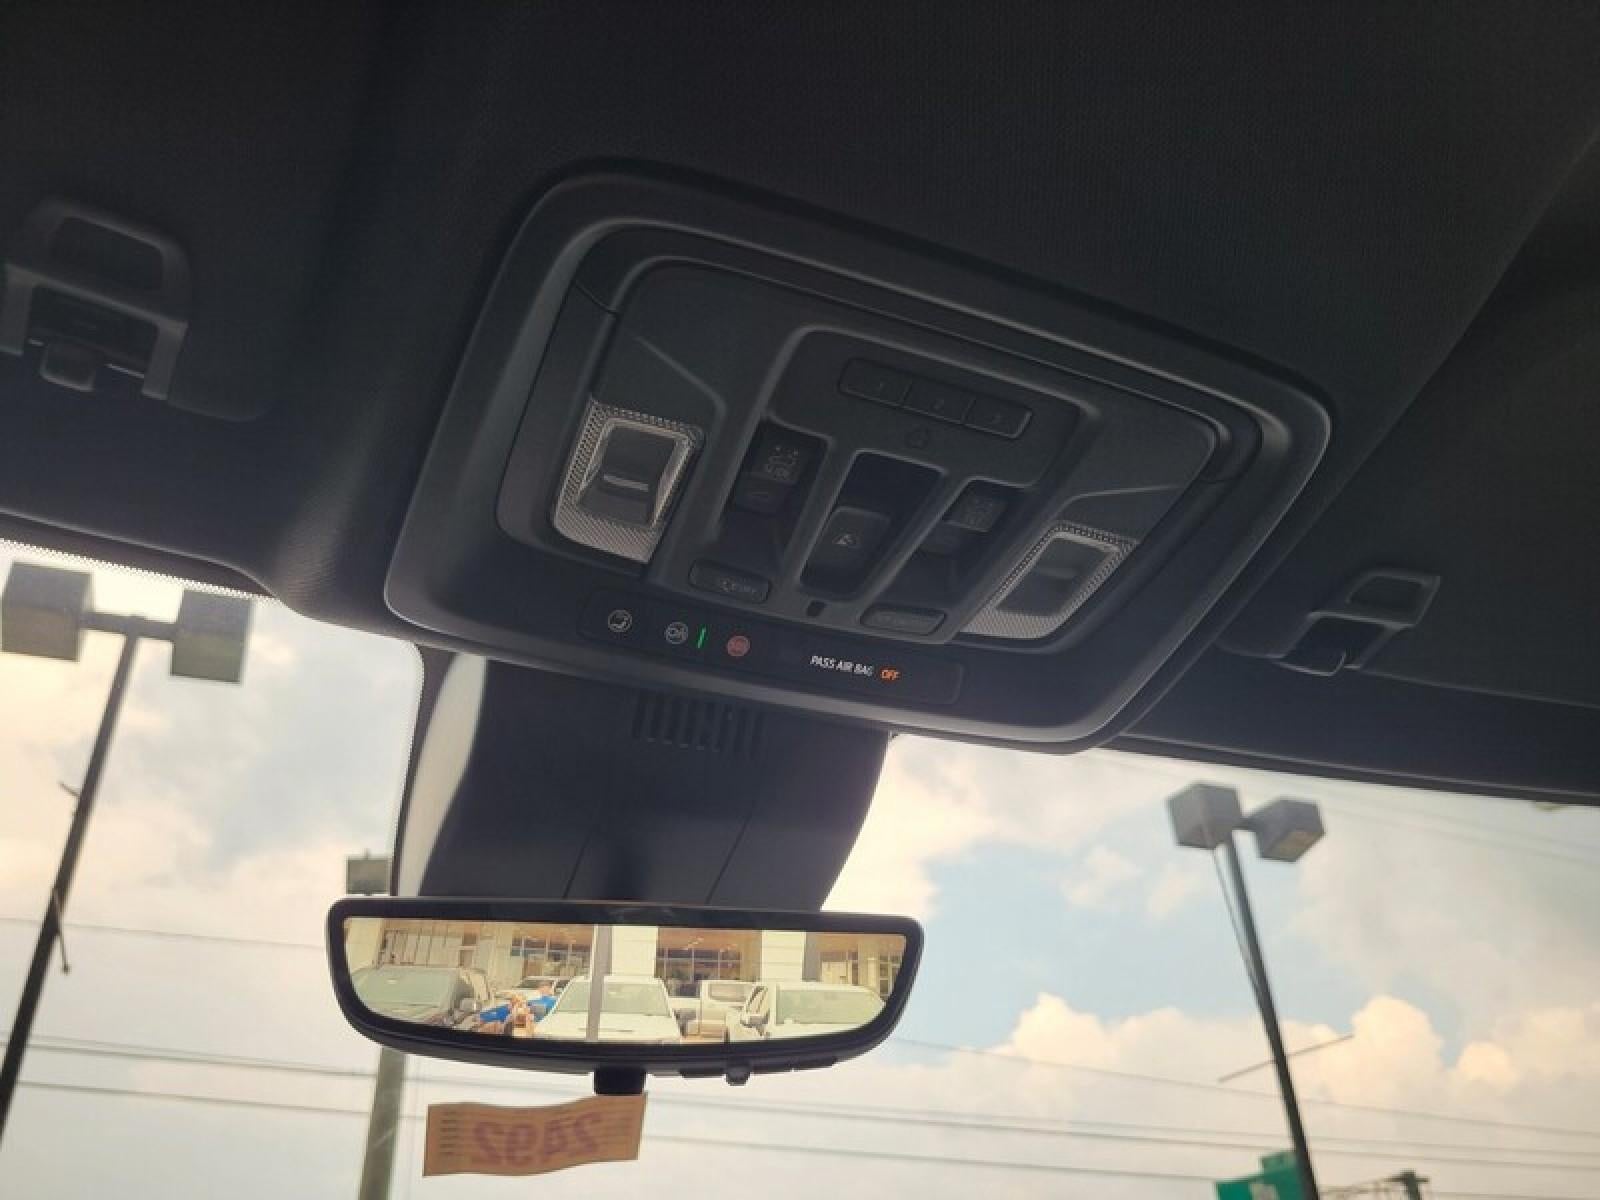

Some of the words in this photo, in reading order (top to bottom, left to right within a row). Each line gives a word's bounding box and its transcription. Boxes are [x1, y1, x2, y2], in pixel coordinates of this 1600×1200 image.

[810, 655, 836, 669] PASS
[836, 660, 853, 673] AIR
[854, 663, 873, 676] BAG
[881, 669, 900, 681] OFF
